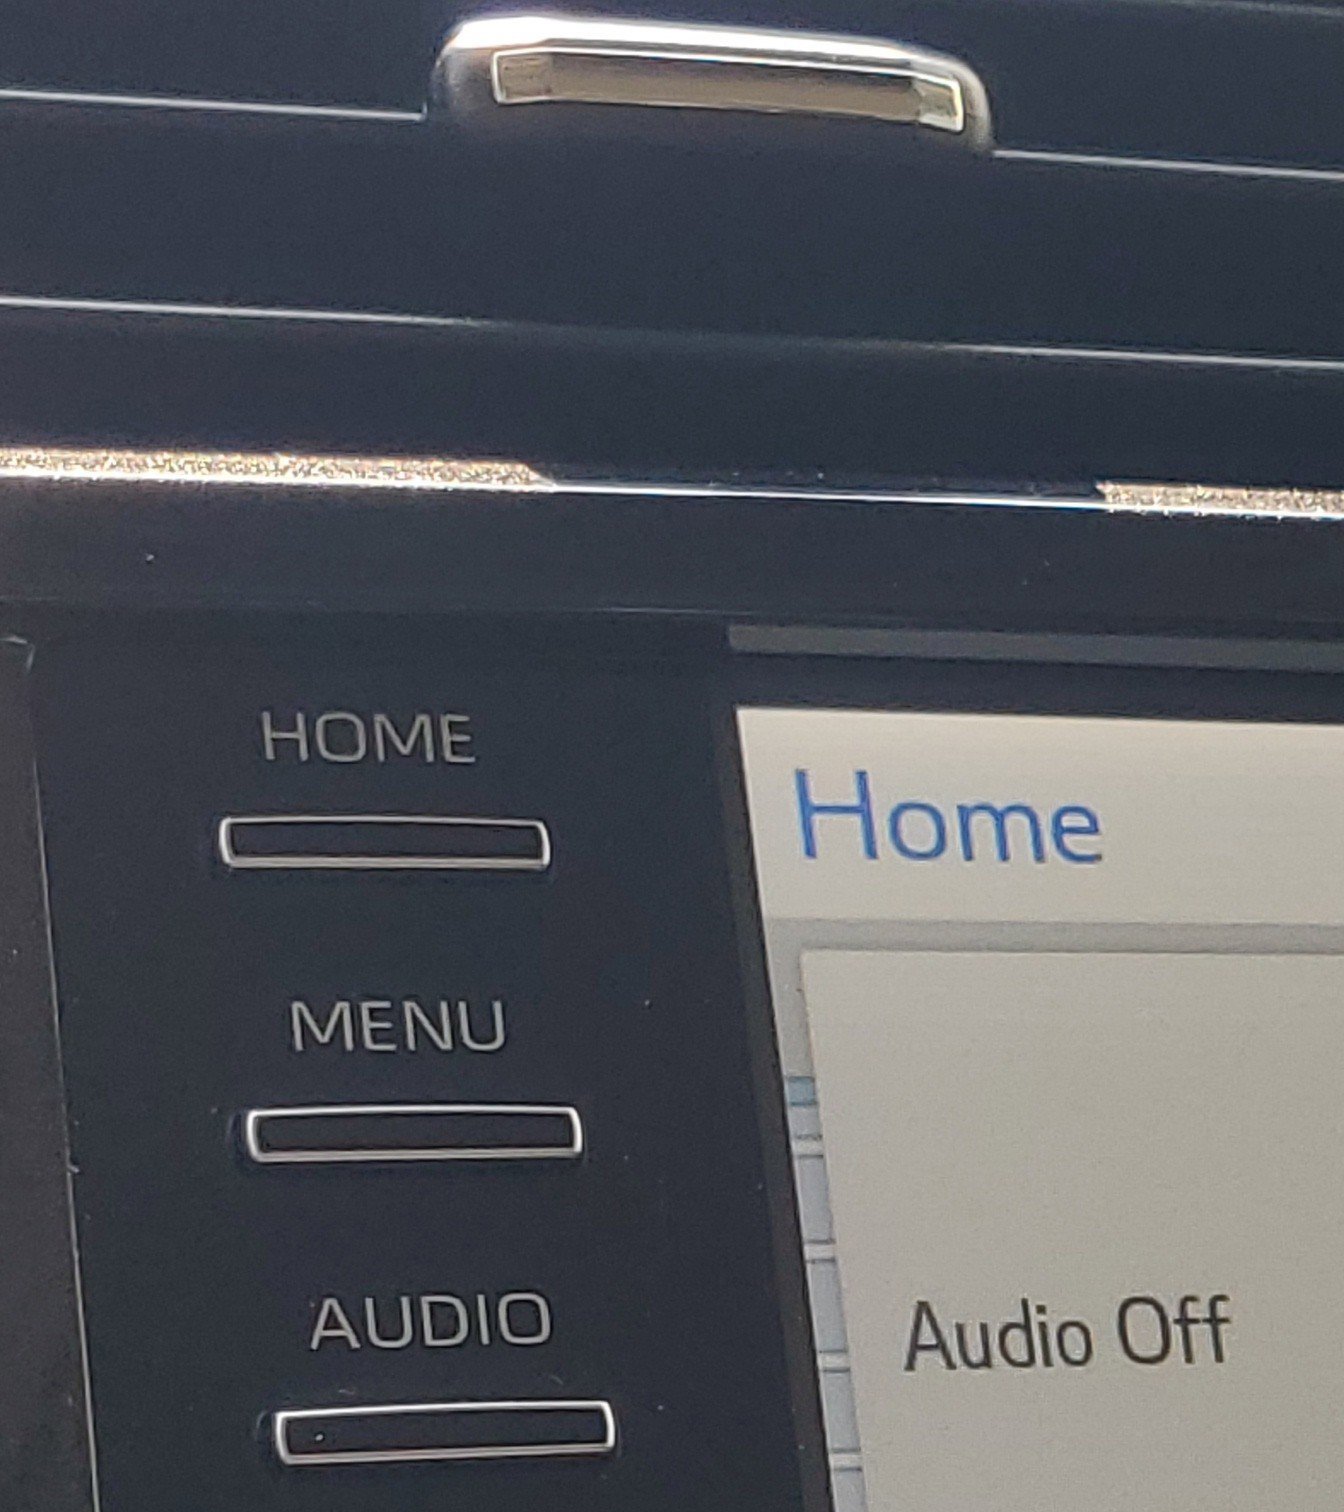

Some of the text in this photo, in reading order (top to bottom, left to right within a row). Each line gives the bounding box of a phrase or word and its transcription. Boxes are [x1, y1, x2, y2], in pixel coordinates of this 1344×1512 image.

[260, 709, 477, 765] HOME
[793, 767, 1103, 865] Home
[289, 999, 507, 1052] MENU
[308, 1291, 554, 1351] AUDIO
[902, 1293, 1233, 1372] Audio Off
